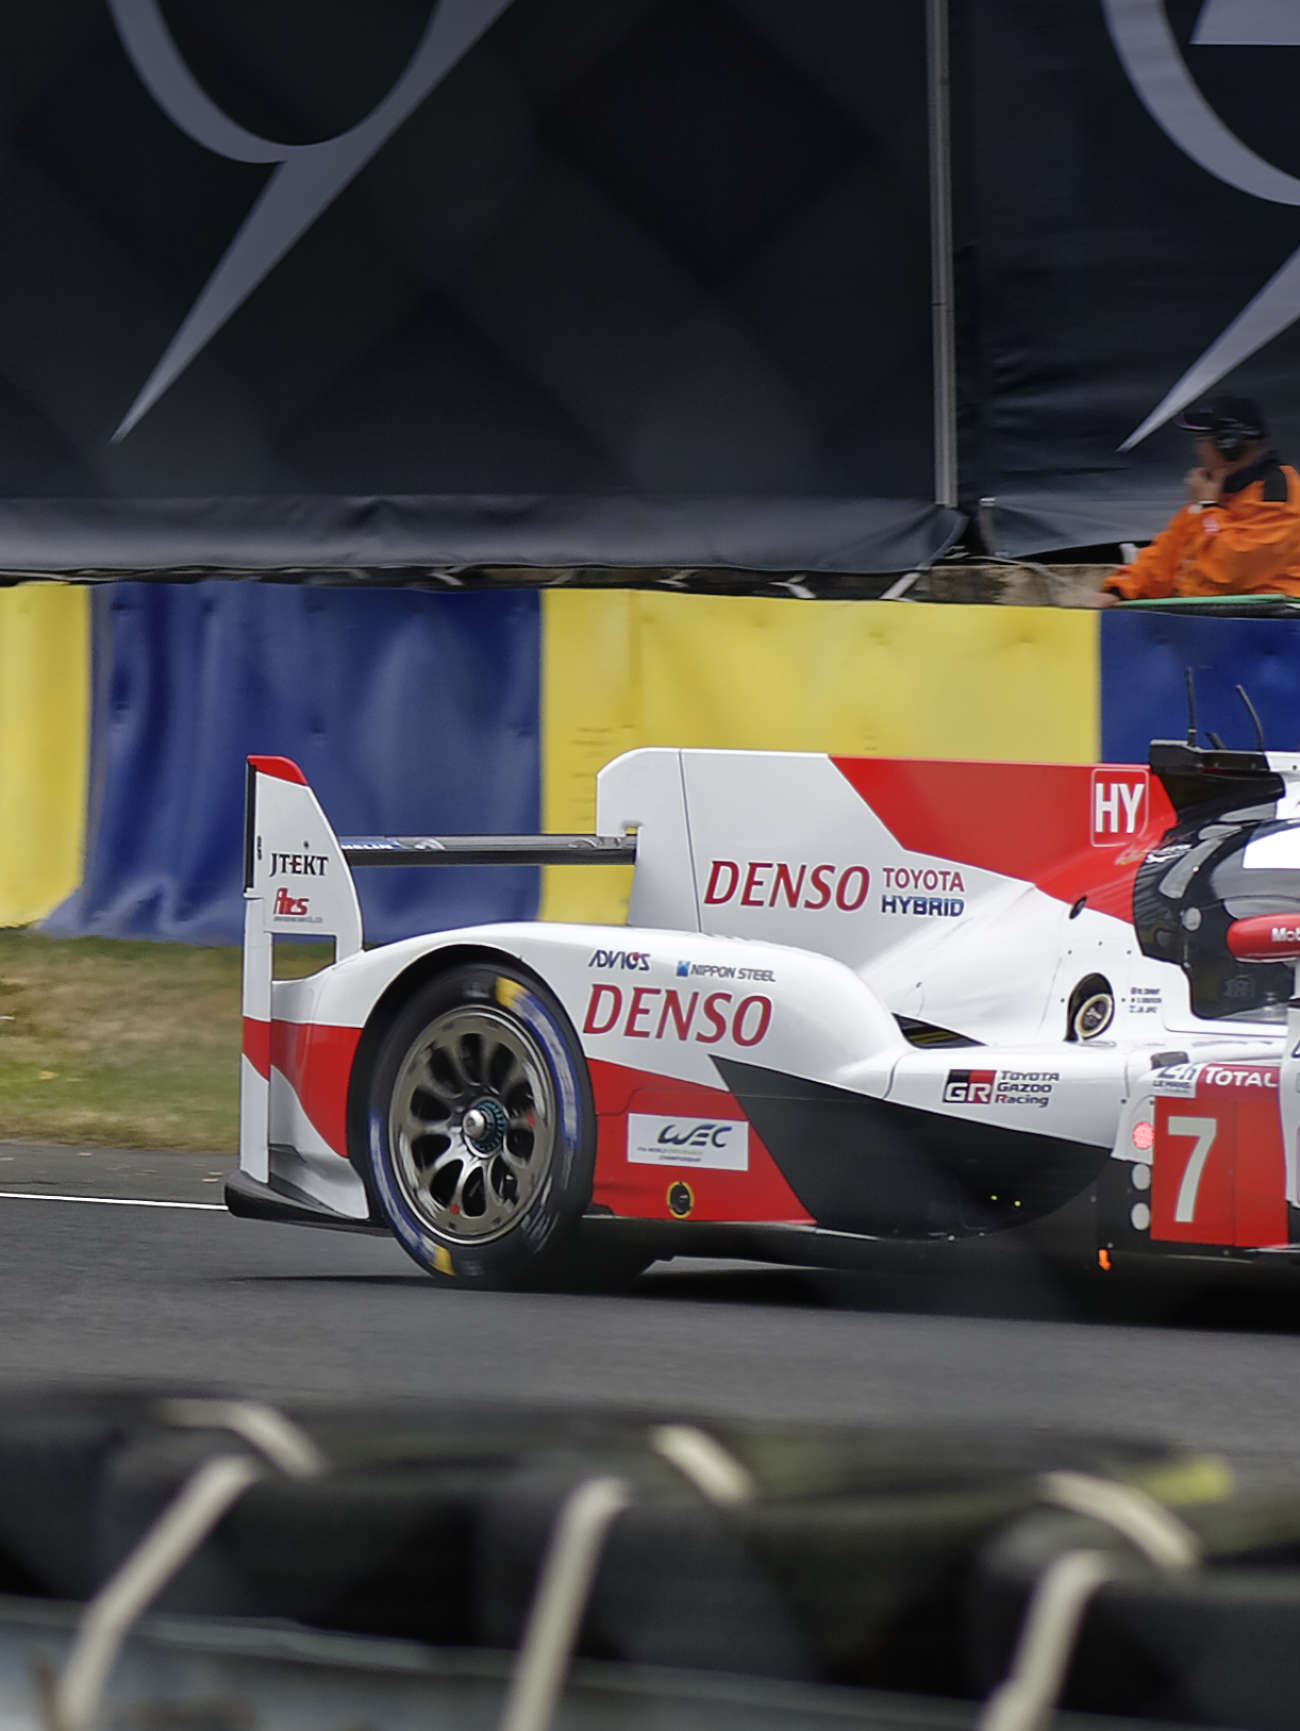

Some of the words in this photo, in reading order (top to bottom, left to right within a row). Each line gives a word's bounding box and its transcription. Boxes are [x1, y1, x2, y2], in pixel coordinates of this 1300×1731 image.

[1095, 783, 1145, 833] HY
[269, 853, 329, 877] JTEKT
[703, 860, 870, 911] DENSO
[882, 867, 965, 892] TOYOTA
[881, 895, 965, 917] HYBRID
[690, 964, 736, 978] NIPPON
[738, 967, 776, 982] STEEL
[582, 983, 772, 1047] DENSO
[997, 1082, 1052, 1093] GAZOO
[1001, 1070, 1060, 1082] TOYOTA
[1204, 1066, 1279, 1088] TOTAL
[944, 1082, 992, 1104] GR
[994, 1094, 1050, 1108] Racing
[657, 1124, 733, 1148] WEC
[1167, 1115, 1218, 1223] 7
